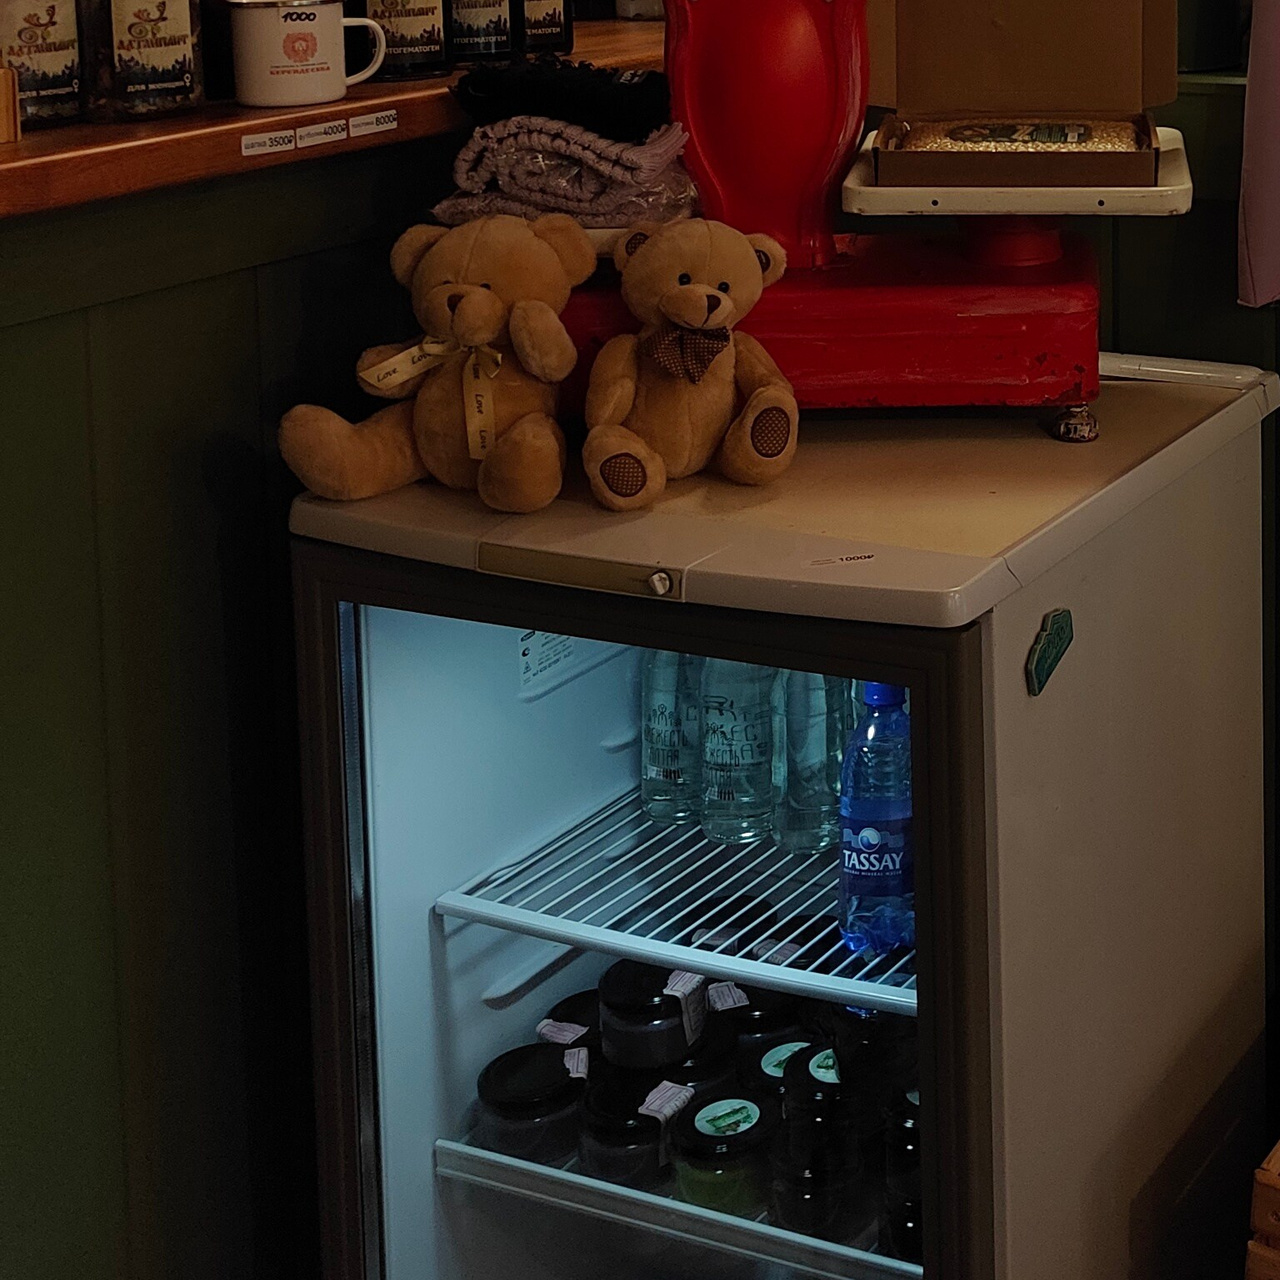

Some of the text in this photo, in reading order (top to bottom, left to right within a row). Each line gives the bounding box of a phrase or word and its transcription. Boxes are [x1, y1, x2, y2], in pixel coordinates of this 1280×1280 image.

[282, 12, 318, 23] 1000
[525, 27, 561, 36] ЕМАТОГЕН
[454, 36, 508, 45] ТОГЕМАТОГЕН
[372, 45, 440, 56] ПНТОГЕМАТОГЕН
[376, 368, 399, 383] Love
[475, 394, 484, 415] Love
[479, 430, 487, 450] Love
[842, 849, 904, 870] TASSAY
